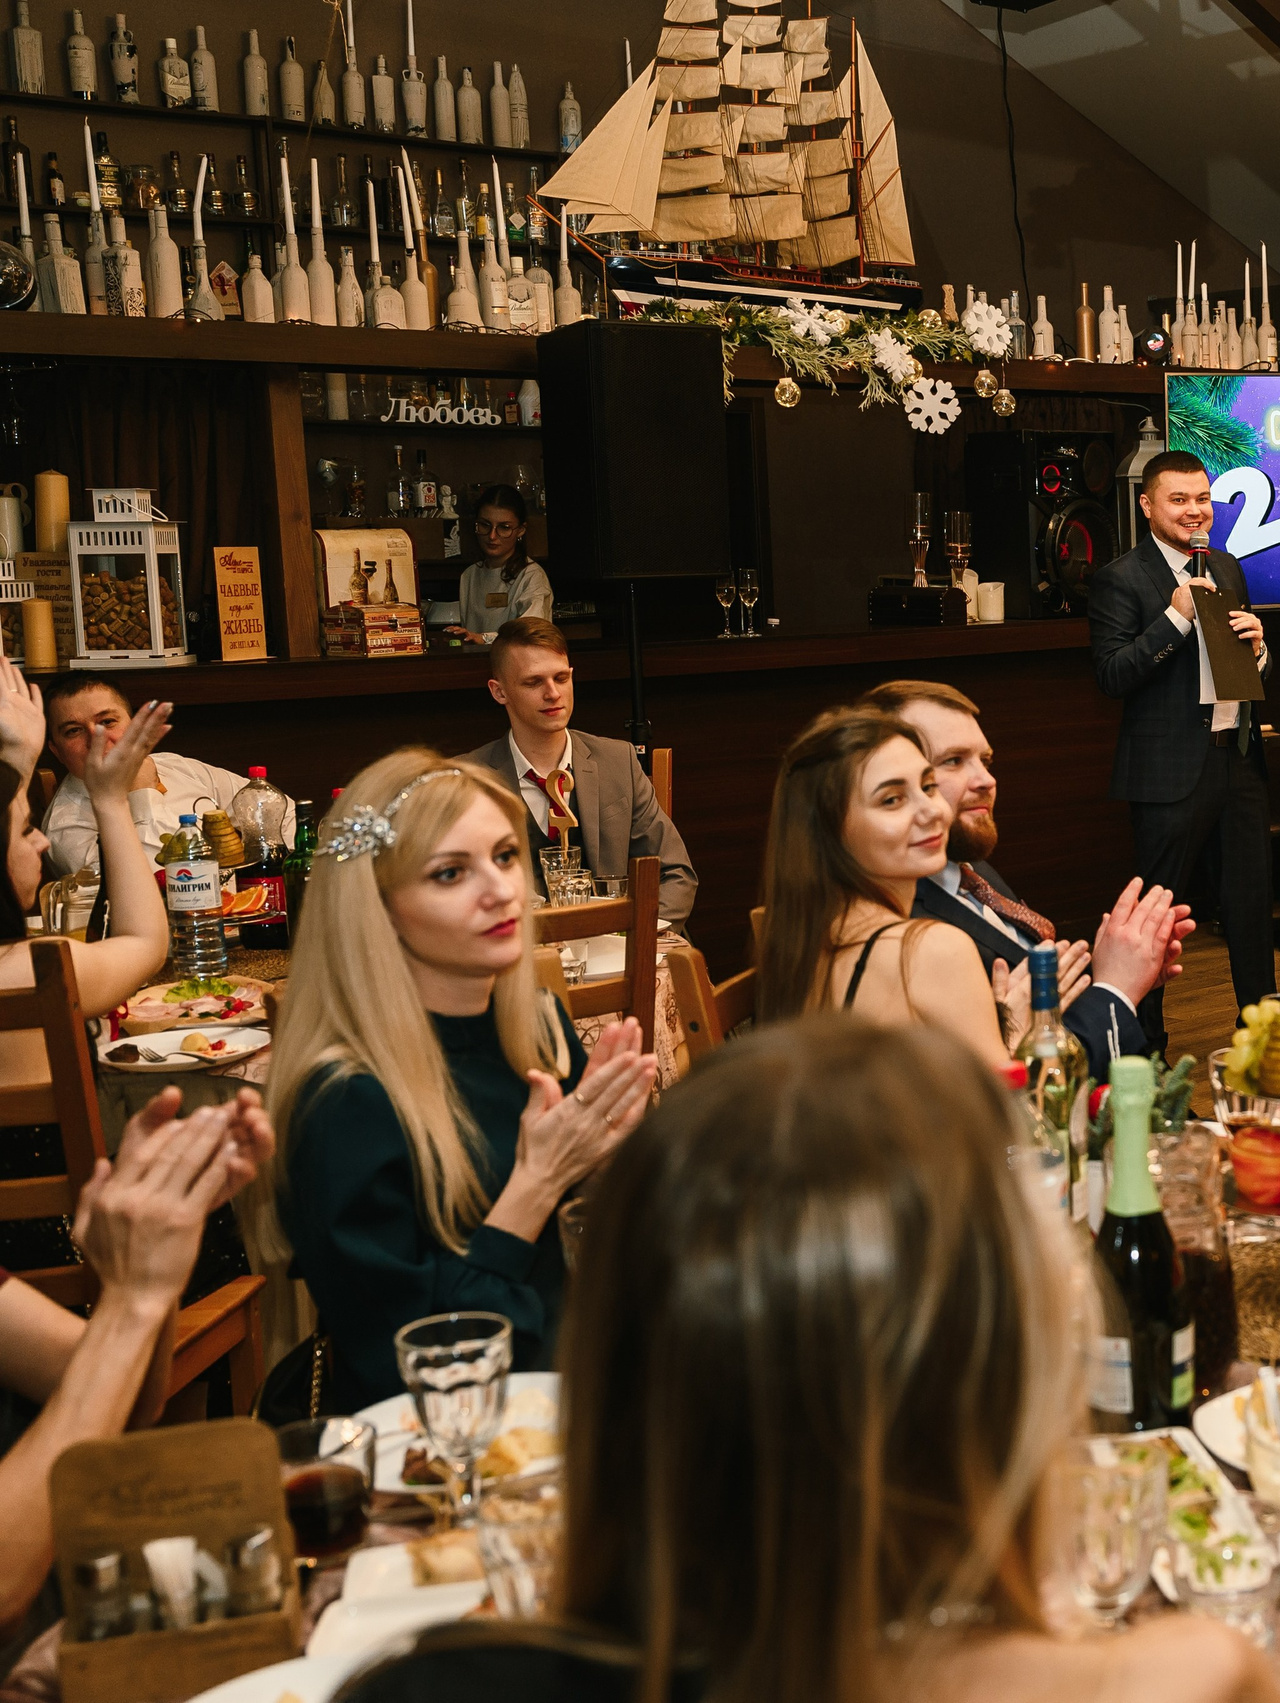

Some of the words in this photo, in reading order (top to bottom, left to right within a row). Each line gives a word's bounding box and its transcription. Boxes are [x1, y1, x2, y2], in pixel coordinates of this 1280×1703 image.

[380, 397, 502, 426] Любовь
[22, 557, 71, 569] Уважаемы
[219, 583, 260, 598] ЧАЕВЫЕ
[222, 618, 263, 635] ЖИЗНЬ
[229, 640, 260, 650] ЭКИПАЖА
